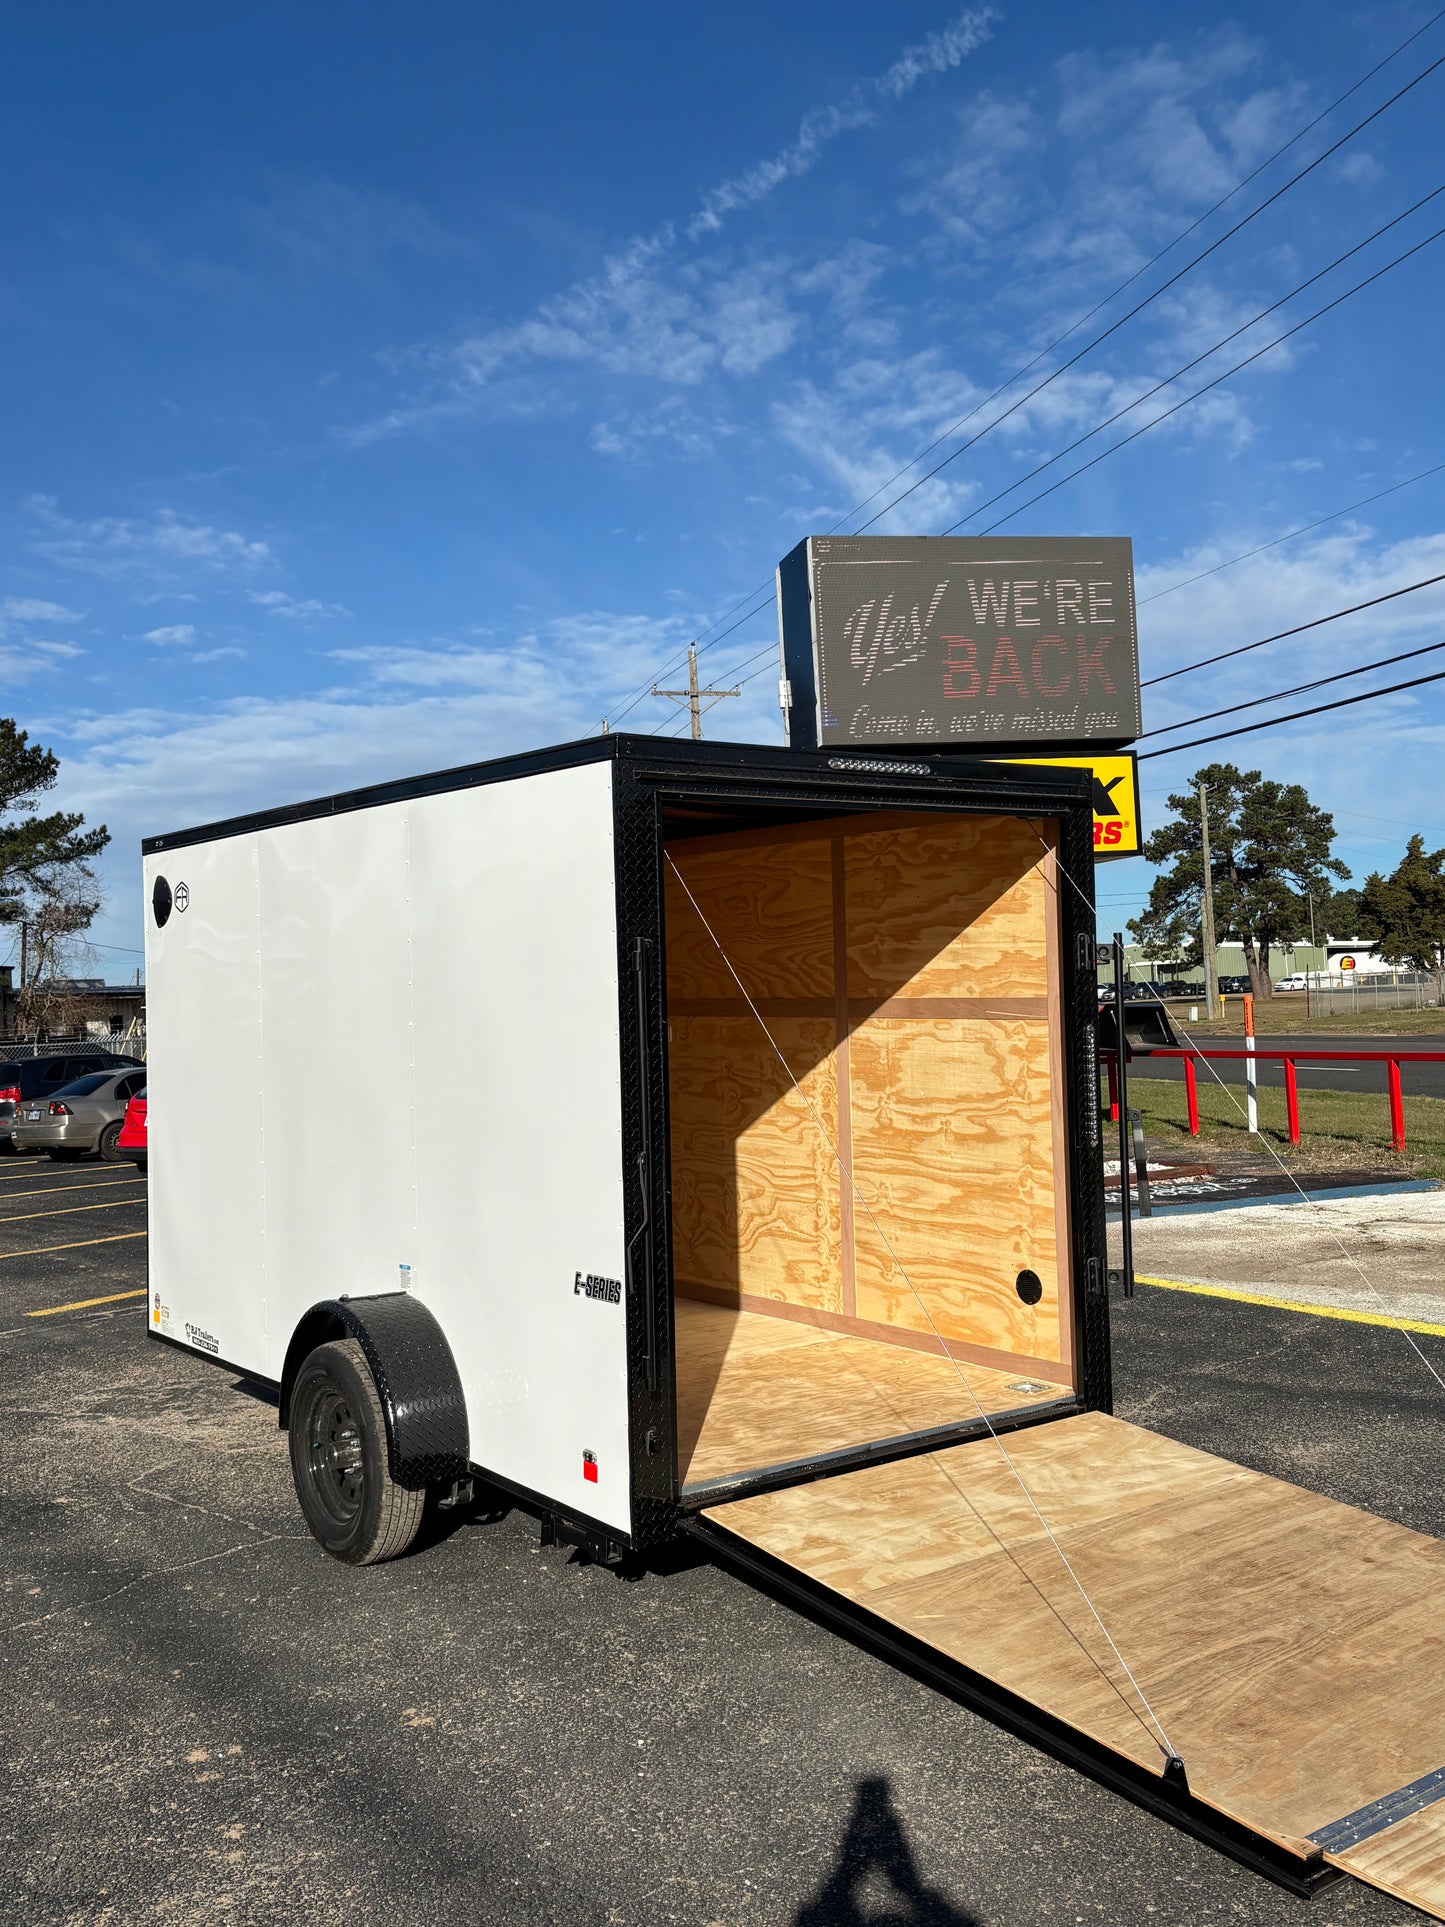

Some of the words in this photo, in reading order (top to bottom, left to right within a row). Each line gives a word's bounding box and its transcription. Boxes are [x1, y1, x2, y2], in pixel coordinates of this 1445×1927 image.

[966, 578, 1116, 626] WE'RE
[843, 579, 950, 686] Yes!
[941, 633, 1119, 698] BACK
[849, 703, 911, 738] Come
[1011, 701, 1080, 732] missed
[573, 1271, 622, 1305] E-SERIES
